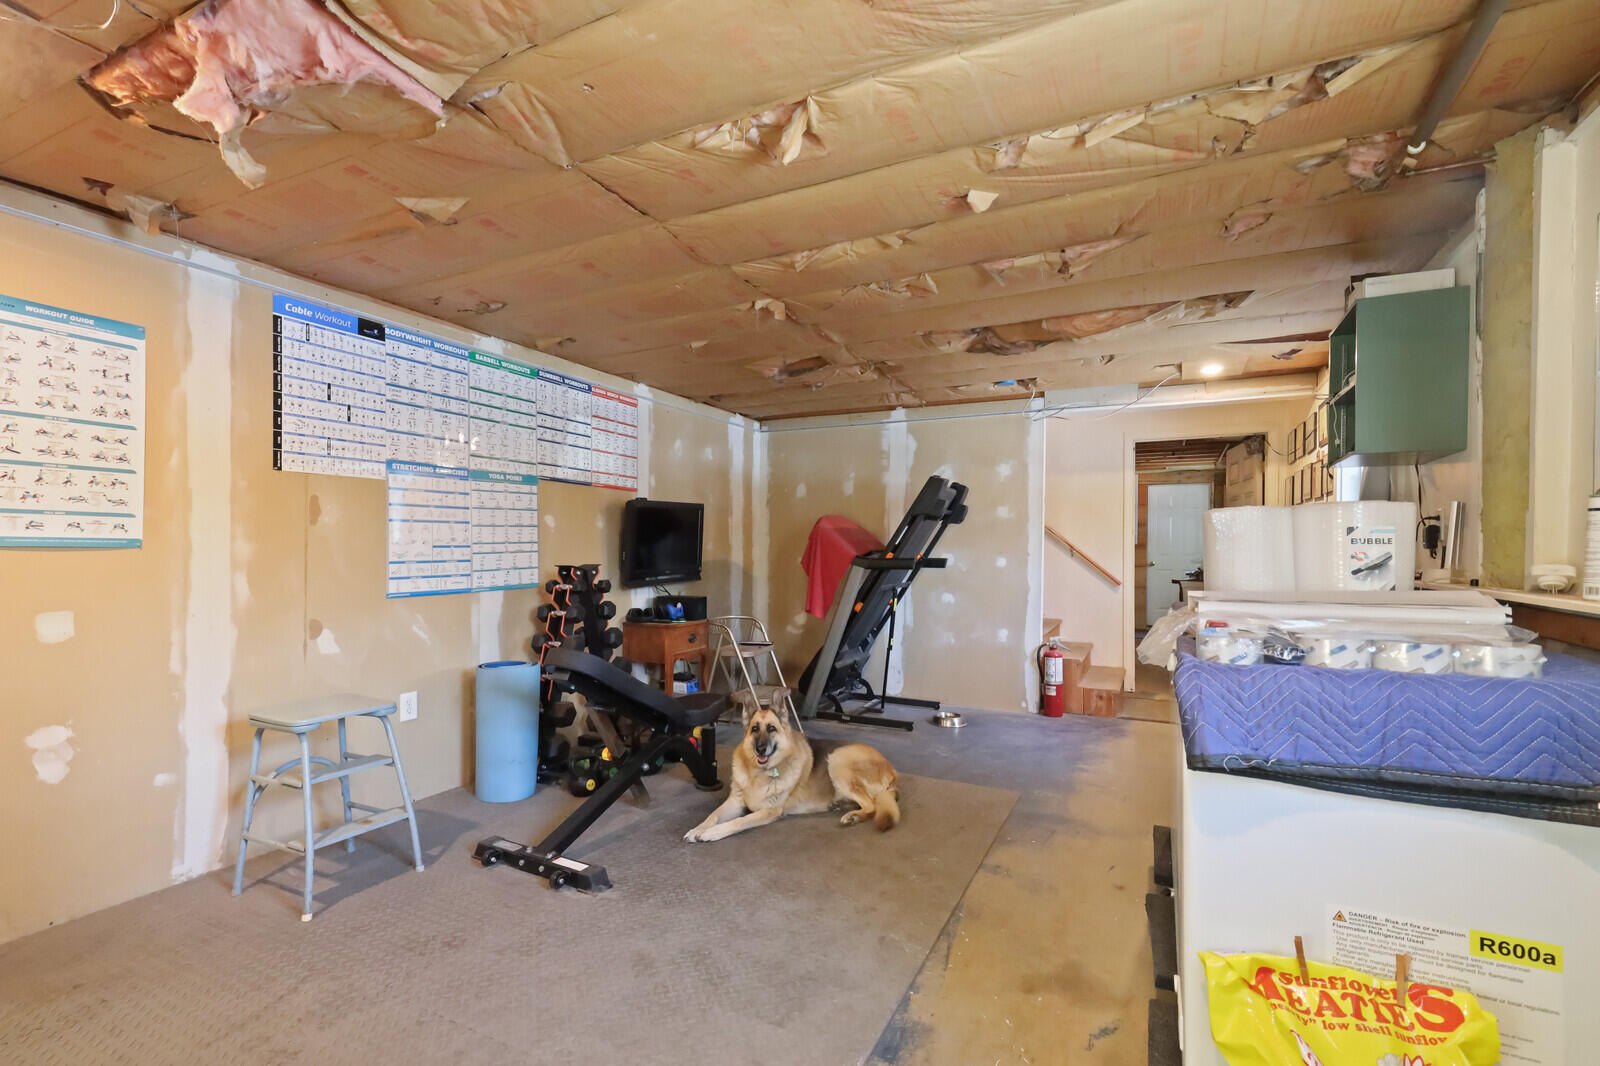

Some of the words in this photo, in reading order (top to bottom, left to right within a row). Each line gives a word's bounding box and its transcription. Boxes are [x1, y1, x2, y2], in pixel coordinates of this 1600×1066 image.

[25, 305, 68, 320] WORKOUT
[69, 314, 95, 326] GUIDE
[285, 303, 313, 316] Cable
[314, 310, 352, 328] Workout
[385, 327, 432, 346] BODYWEIGHT
[434, 340, 469, 357] WORKOUTS
[475, 353, 500, 366] BARBELL
[500, 361, 531, 374] WORKOUTS
[392, 463, 434, 473] STRETCHING
[488, 473, 505, 481] YOGA
[1350, 537, 1393, 545] BUBBLE
[1348, 911, 1378, 921] DANGER
[1384, 917, 1399, 925] Risk
[1332, 922, 1367, 934] Flammable
[1368, 929, 1405, 941] Refrigerant
[1406, 936, 1425, 945] Used
[1479, 936, 1557, 966] R600a
[1322, 1019, 1349, 1031] low
[1355, 1023, 1393, 1037] shell
